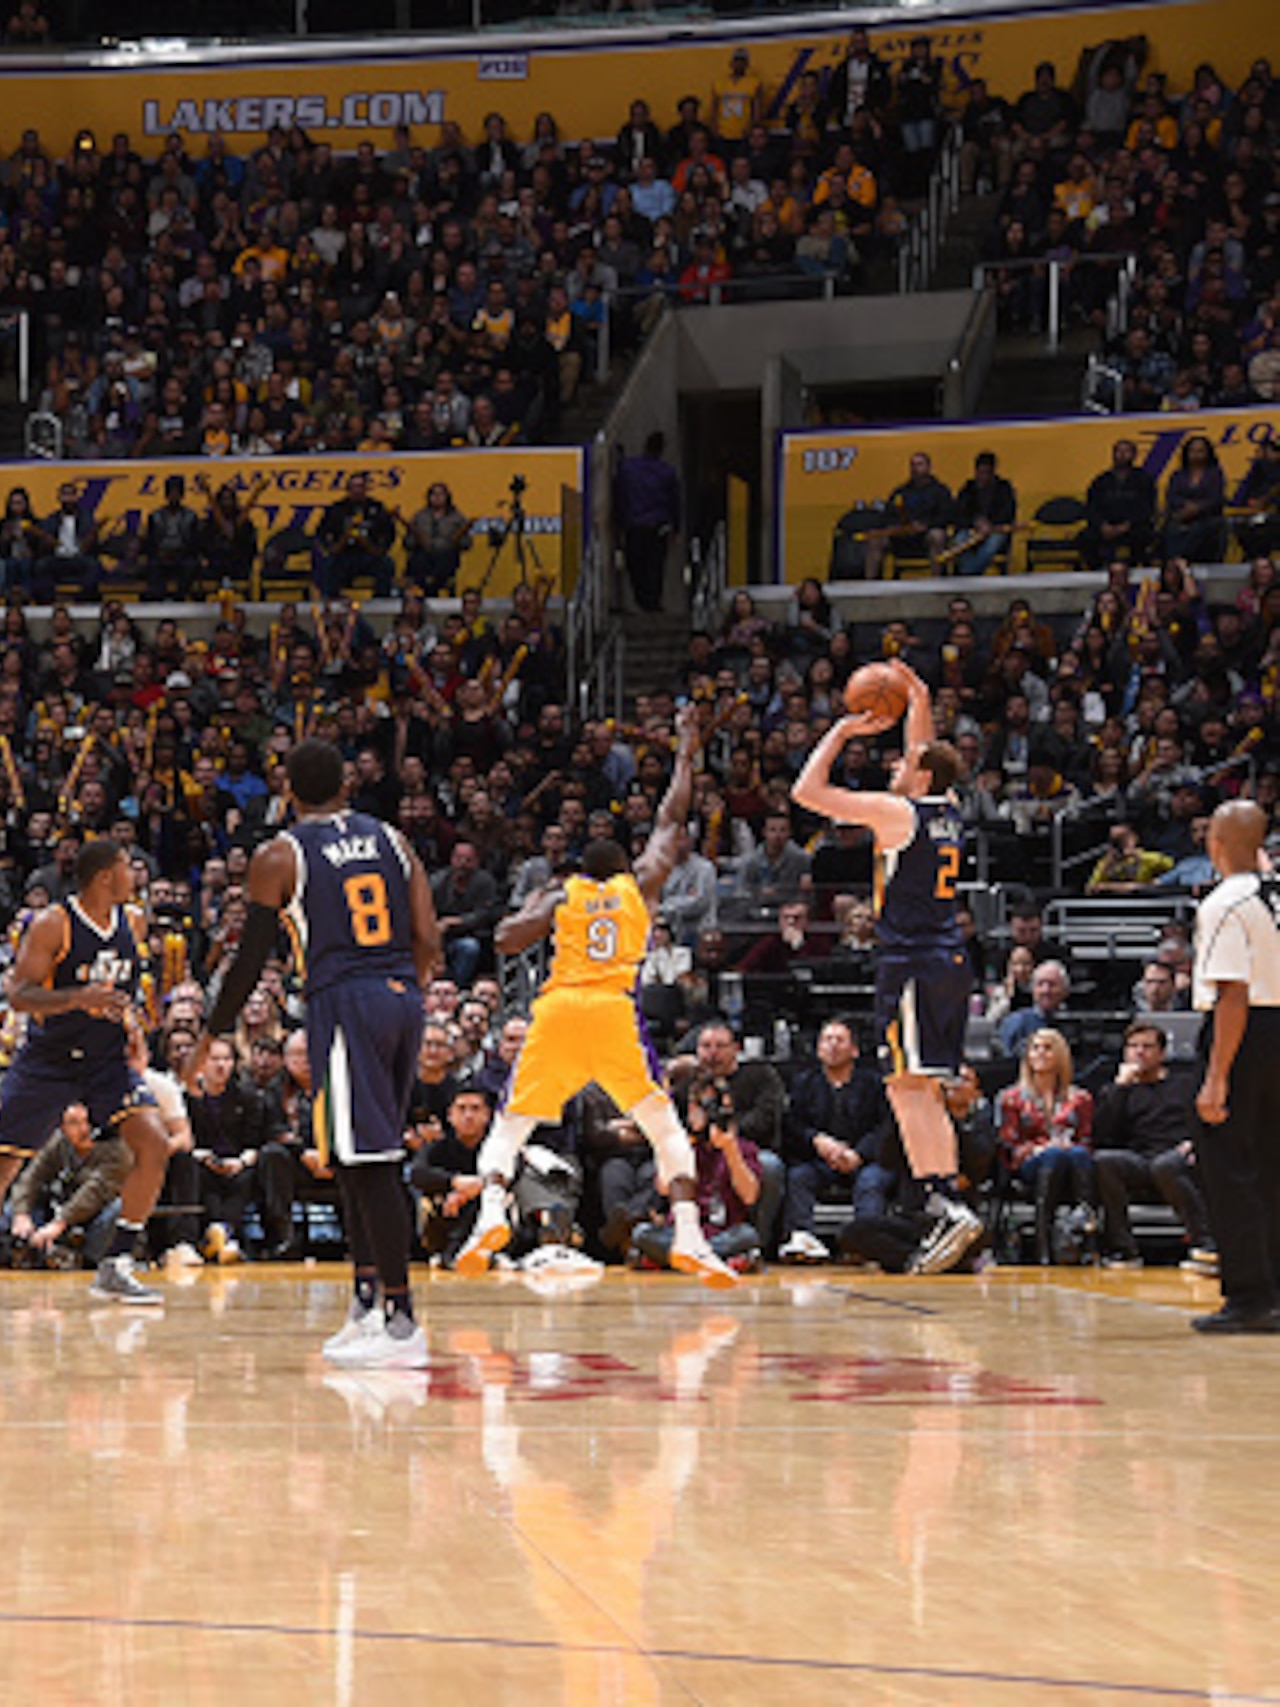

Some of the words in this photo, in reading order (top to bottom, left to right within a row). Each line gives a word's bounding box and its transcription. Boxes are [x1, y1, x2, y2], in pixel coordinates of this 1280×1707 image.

[142, 89, 446, 136] LAKERS.COM
[803, 446, 857, 473] 107
[138, 472, 212, 496] LS
[933, 845, 959, 899] 2
[343, 872, 394, 947] 8
[587, 917, 617, 961] 9
